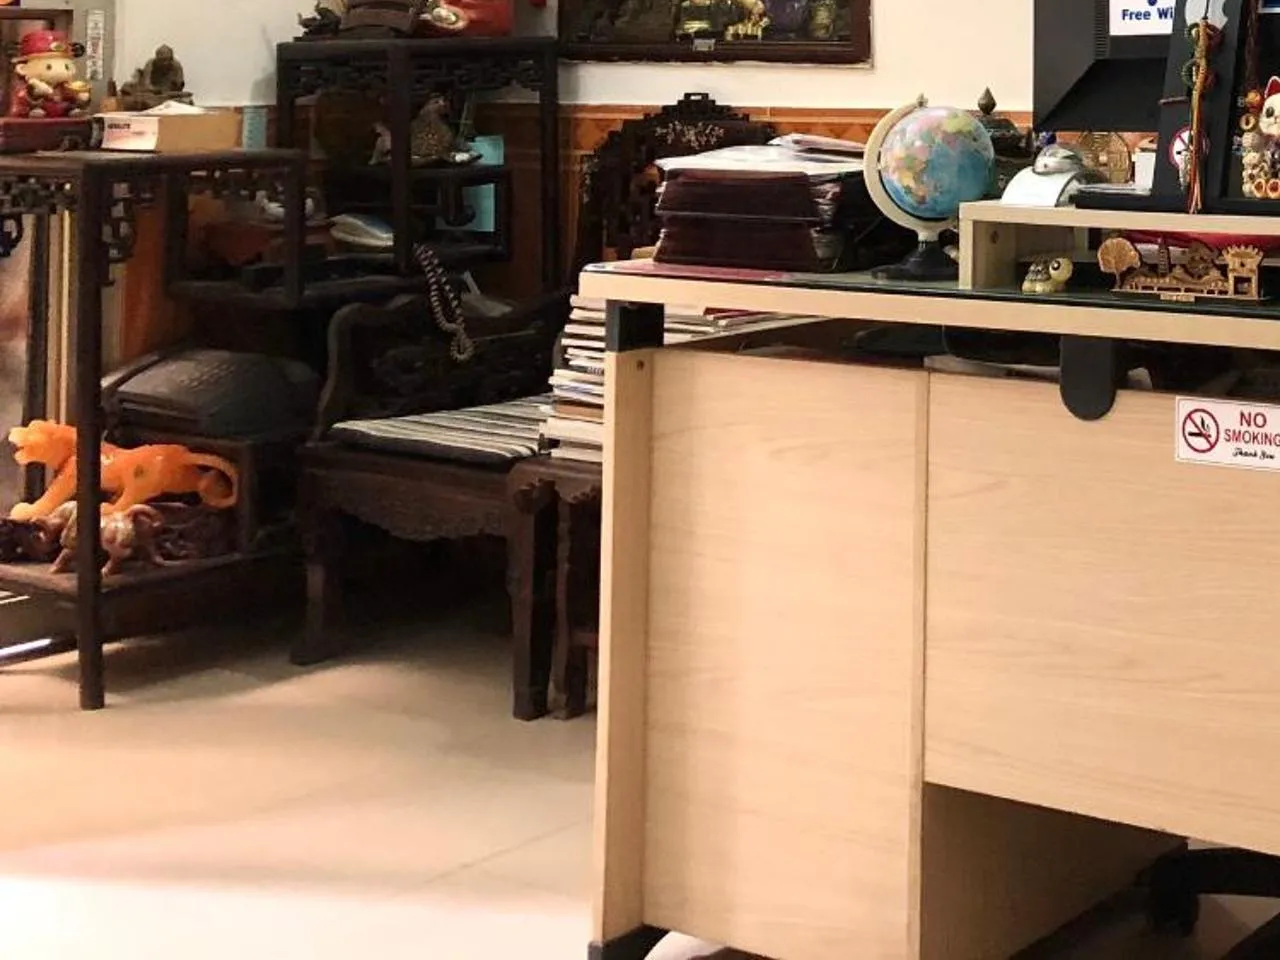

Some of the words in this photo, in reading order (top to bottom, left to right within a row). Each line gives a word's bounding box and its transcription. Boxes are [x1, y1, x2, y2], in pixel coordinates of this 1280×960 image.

[1121, 8, 1151, 20] Free
[1157, 6, 1174, 20] Wi
[1240, 410, 1267, 428] NO
[1232, 447, 1258, 458] Thank
[1259, 449, 1275, 460] You
